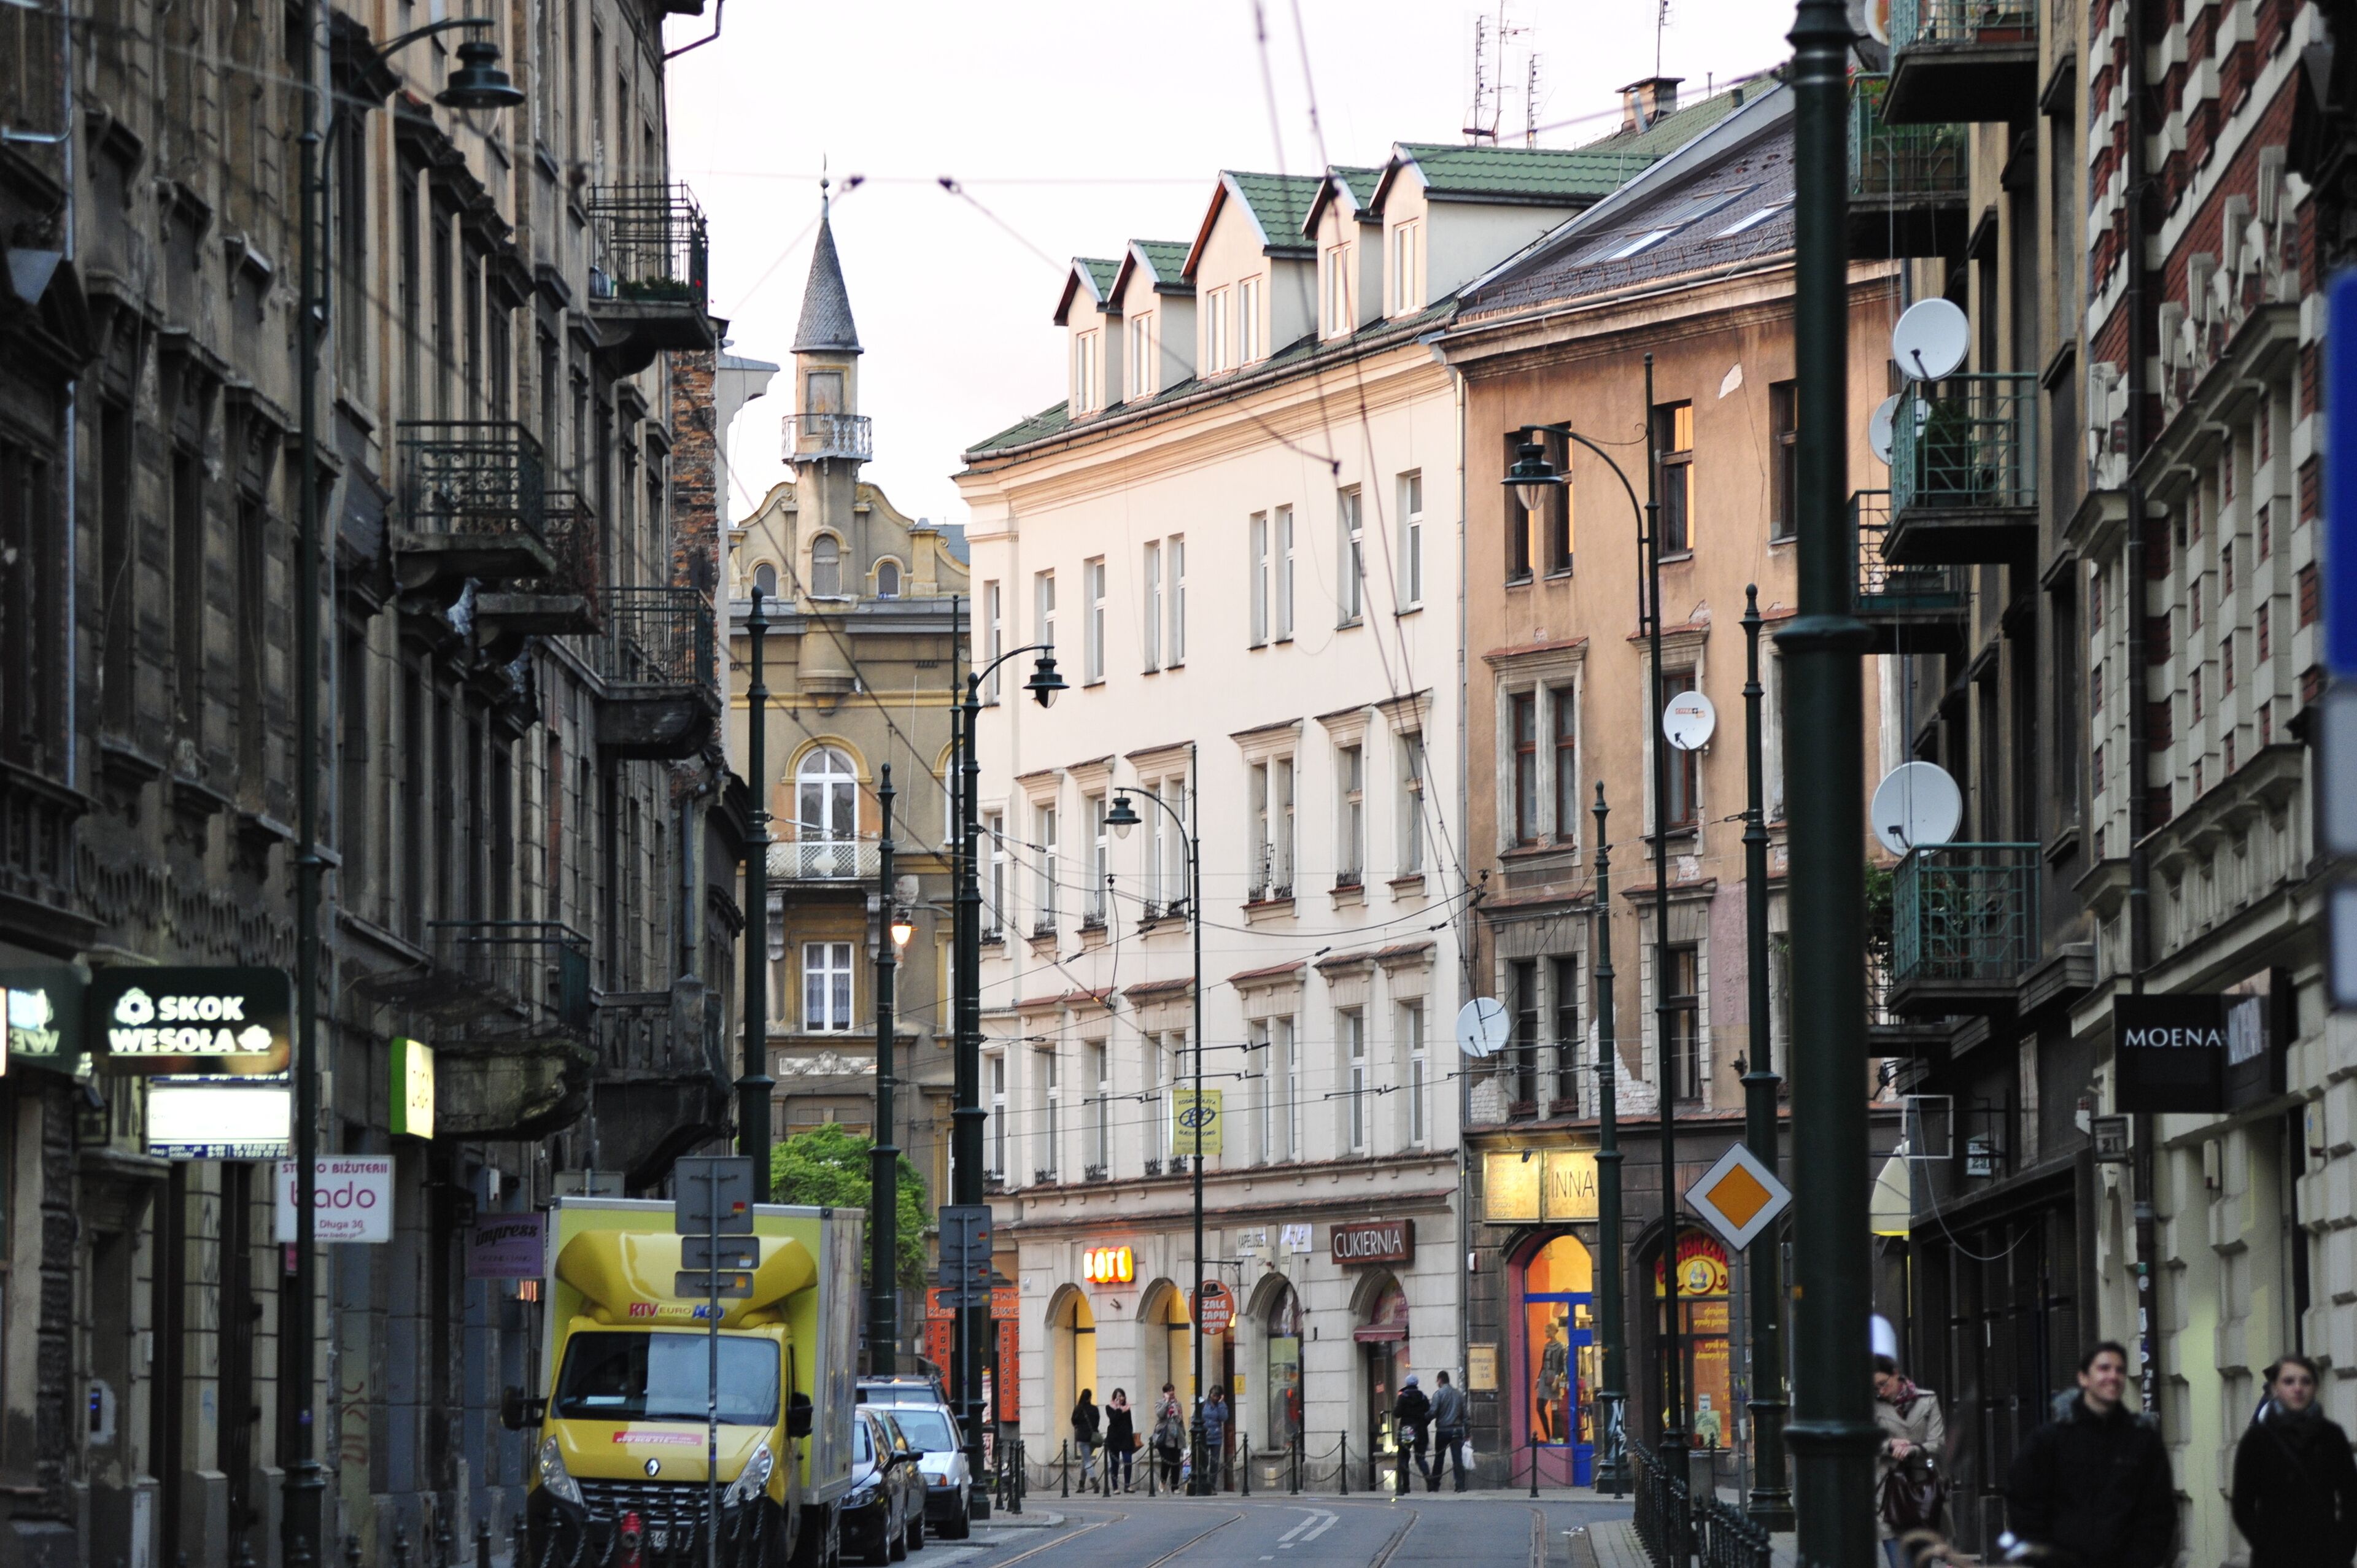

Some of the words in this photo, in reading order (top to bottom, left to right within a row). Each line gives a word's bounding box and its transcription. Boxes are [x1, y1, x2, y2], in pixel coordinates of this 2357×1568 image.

[158, 995, 245, 1021] SKOK
[108, 1027, 236, 1053] WESOŁA
[2126, 1028, 2222, 1047] MOENA
[282, 1164, 327, 1173] STO
[332, 1160, 388, 1173] BIŻUTERII
[1551, 1170, 1595, 1199] INNA
[319, 1219, 349, 1230] Długa
[476, 1224, 539, 1247] impress
[1334, 1229, 1403, 1258] CUKIERNIA
[629, 1303, 659, 1317] RTV
[1202, 1300, 1226, 1309] ZALE
[1202, 1310, 1229, 1320] ZAPKI
